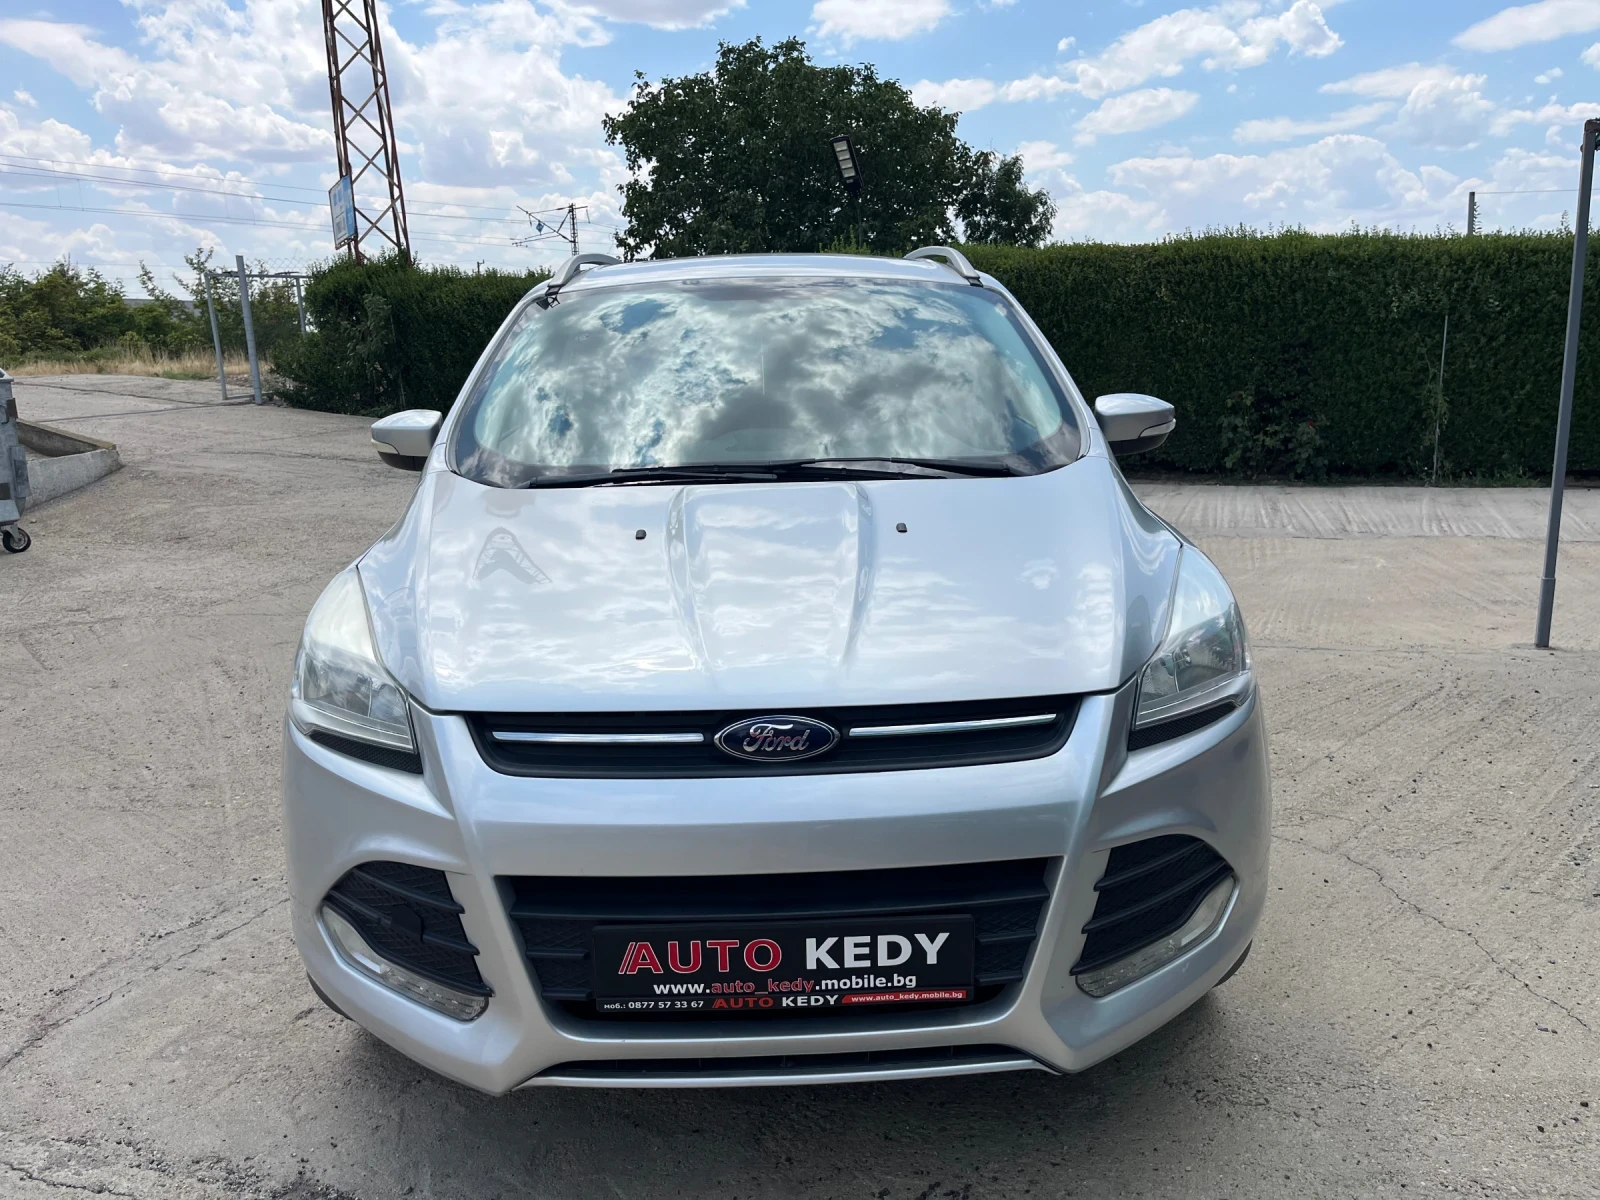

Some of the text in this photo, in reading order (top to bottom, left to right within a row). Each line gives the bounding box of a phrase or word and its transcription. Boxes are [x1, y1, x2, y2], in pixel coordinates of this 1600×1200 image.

[742, 723, 811, 752] Ford
[618, 932, 950, 975] AUTO KEDY
[653, 973, 917, 995] www.auto_kedy.mobile.bg
[628, 1001, 655, 1009] 0877
[658, 1001, 672, 1009] 57
[690, 1000, 704, 1008] 67
[712, 994, 839, 1009] AUTO KEDY
[851, 991, 963, 1002] www.auto_kedy.mobile.bg
